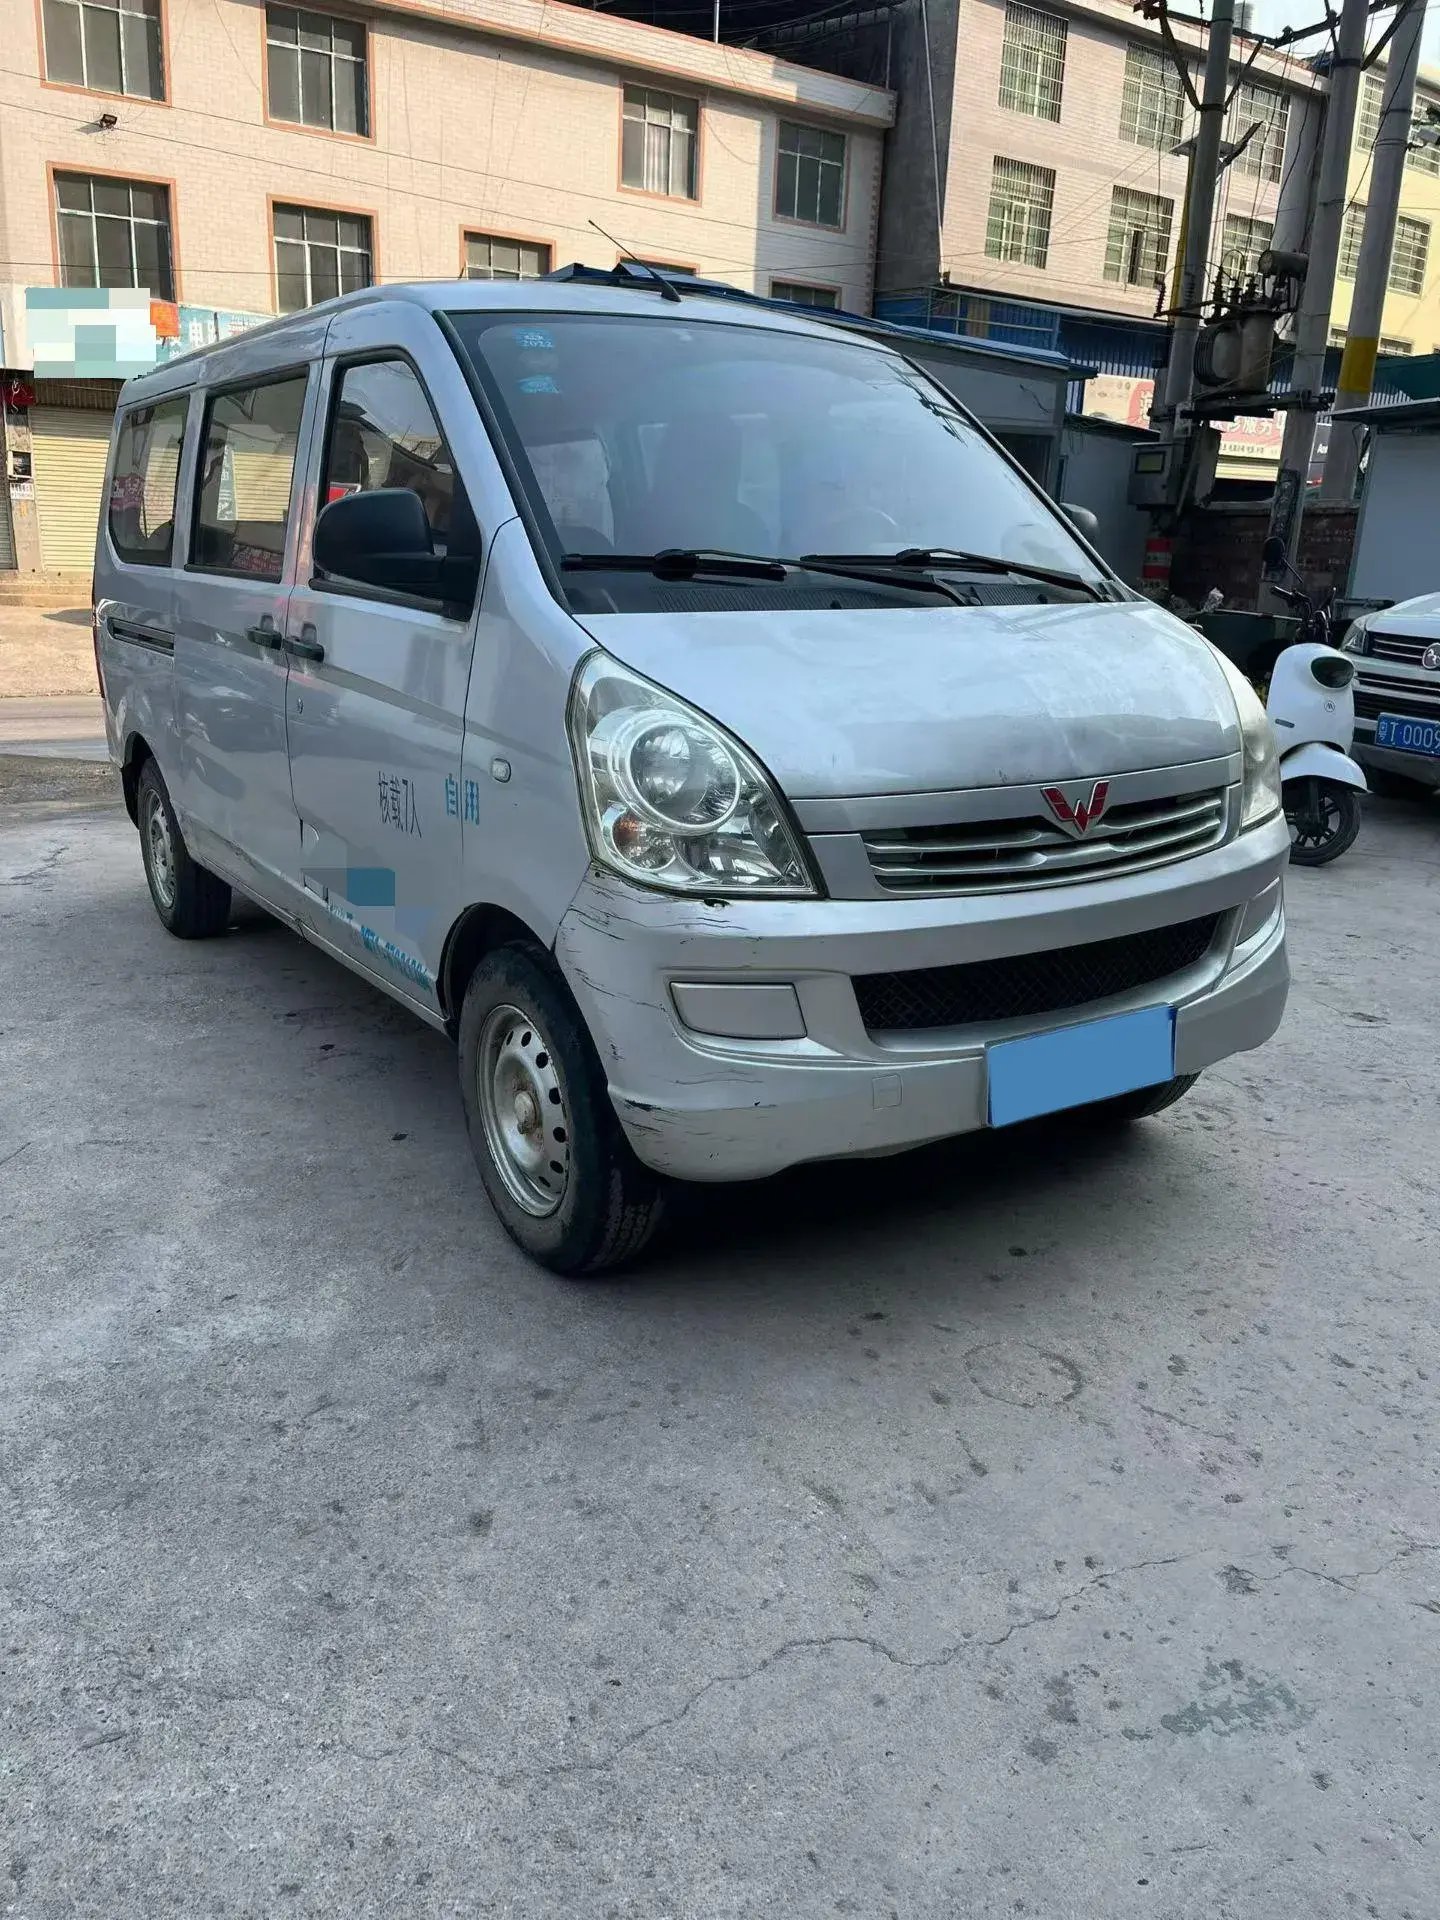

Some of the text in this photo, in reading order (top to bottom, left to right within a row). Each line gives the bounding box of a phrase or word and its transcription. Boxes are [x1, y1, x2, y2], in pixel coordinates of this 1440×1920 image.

[378, 770, 422, 838] 核载7人
[445, 773, 480, 826] 自用
